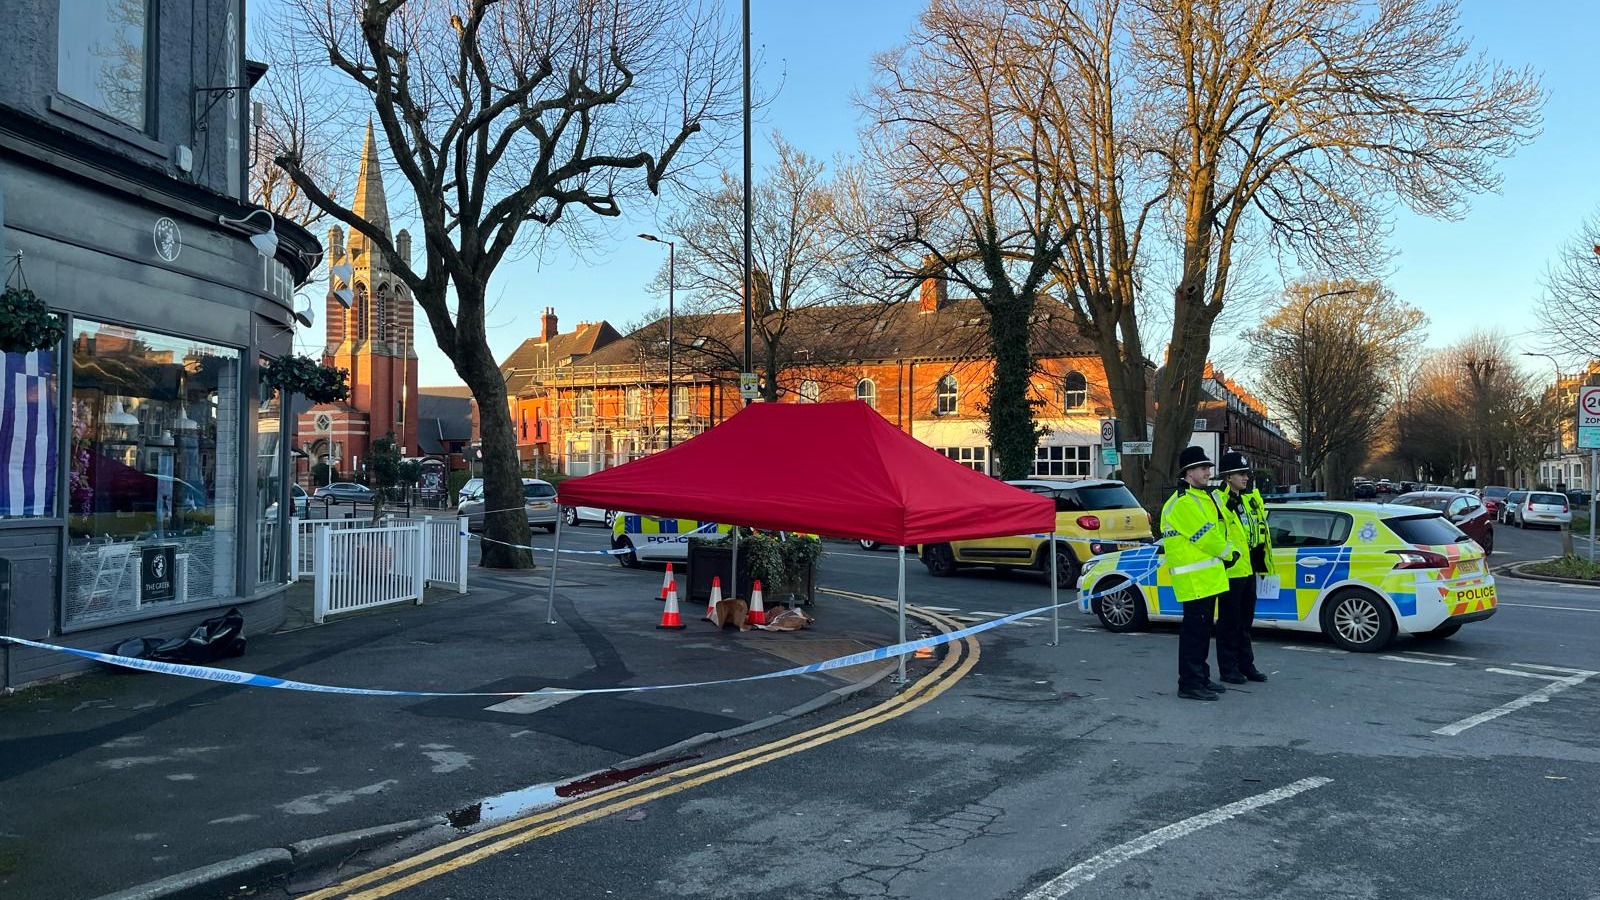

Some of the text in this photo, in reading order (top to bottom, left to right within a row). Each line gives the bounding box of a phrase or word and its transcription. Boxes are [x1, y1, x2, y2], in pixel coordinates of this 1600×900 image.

[1587, 397, 1600, 408] 2
[1103, 427, 1112, 436] 20
[647, 536, 688, 544] POLIC
[1457, 586, 1494, 601] POLICE
